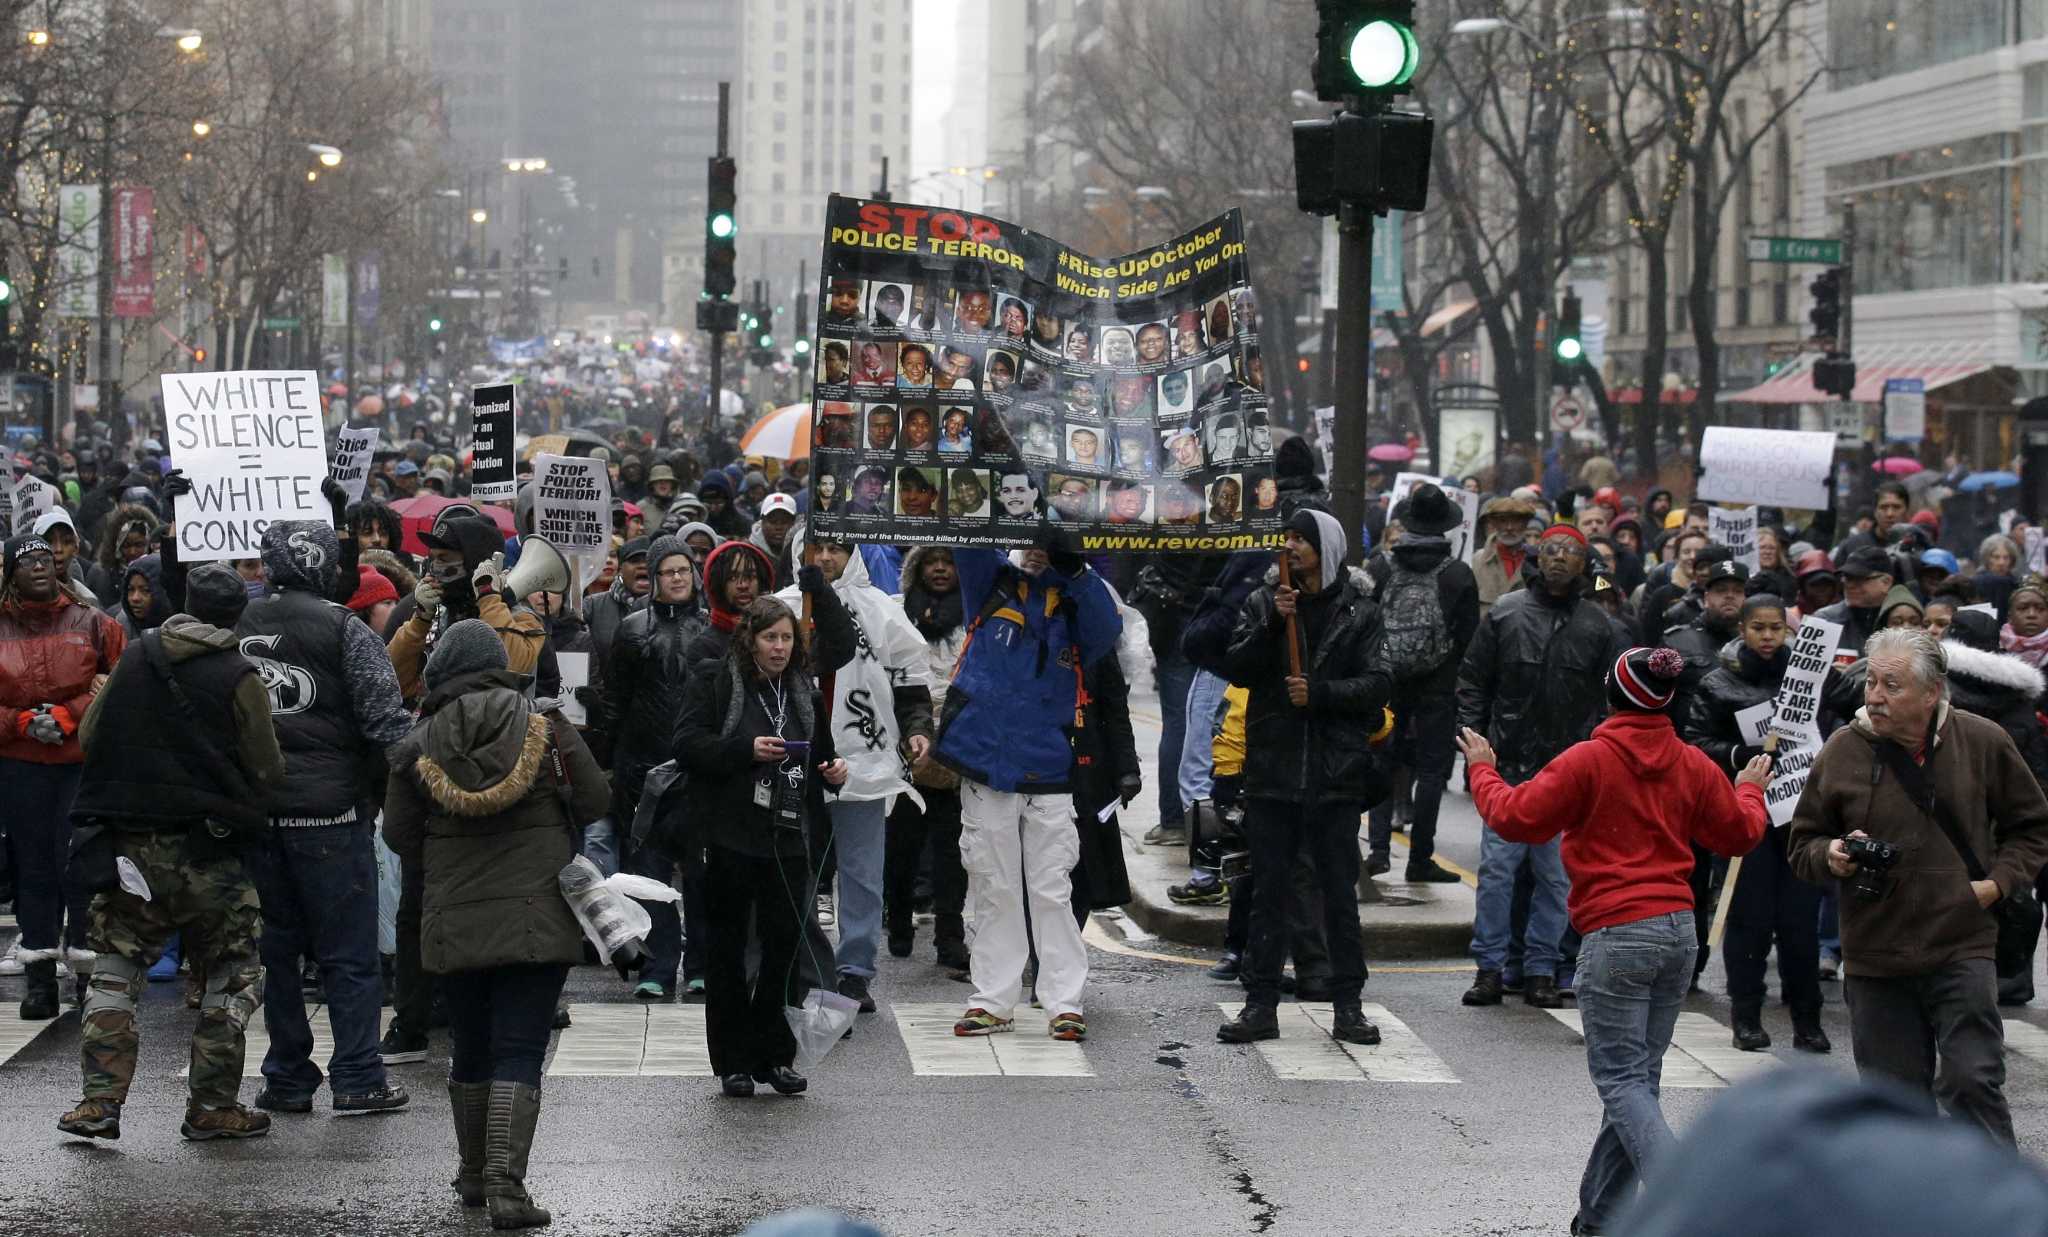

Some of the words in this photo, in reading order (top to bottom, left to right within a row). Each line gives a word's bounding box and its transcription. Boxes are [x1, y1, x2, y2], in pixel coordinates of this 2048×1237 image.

[858, 203, 1001, 242] STOP
[831, 227, 918, 252] POLICE
[928, 237, 1025, 271] TERROR
[1058, 226, 1223, 279] #RiseUpOctober
[1056, 273, 1110, 298] Which
[1118, 280, 1158, 298] Side
[1163, 269, 1191, 288] Are
[1194, 254, 1219, 274] You
[177, 377, 308, 410] WHITE
[175, 413, 318, 449] SILENCE
[481, 423, 493, 433] an
[336, 454, 353, 467] or
[550, 463, 588, 475] STOP
[544, 475, 595, 488] POLICE
[1708, 475, 1792, 501] POLICE
[189, 476, 313, 512] WHITE
[539, 486, 601, 501] TERROR!
[544, 508, 597, 522] WHICH
[540, 520, 573, 532] SIDE
[575, 521, 603, 534] ARE
[541, 532, 570, 544] YOU
[573, 534, 602, 545] ON?
[879, 532, 892, 540] the
[893, 533, 935, 541] thousands
[936, 534, 958, 543] killed
[959, 535, 969, 544] by
[969, 535, 994, 544] police
[994, 537, 1034, 546] nationwide
[1082, 533, 1287, 550] www.revcom.us
[1727, 530, 1745, 544] for
[1793, 639, 1826, 658] LICE
[1778, 691, 1787, 705] E
[1788, 693, 1816, 711] ARE
[1781, 707, 1812, 725] ON?
[551, 748, 562, 777] Canon
